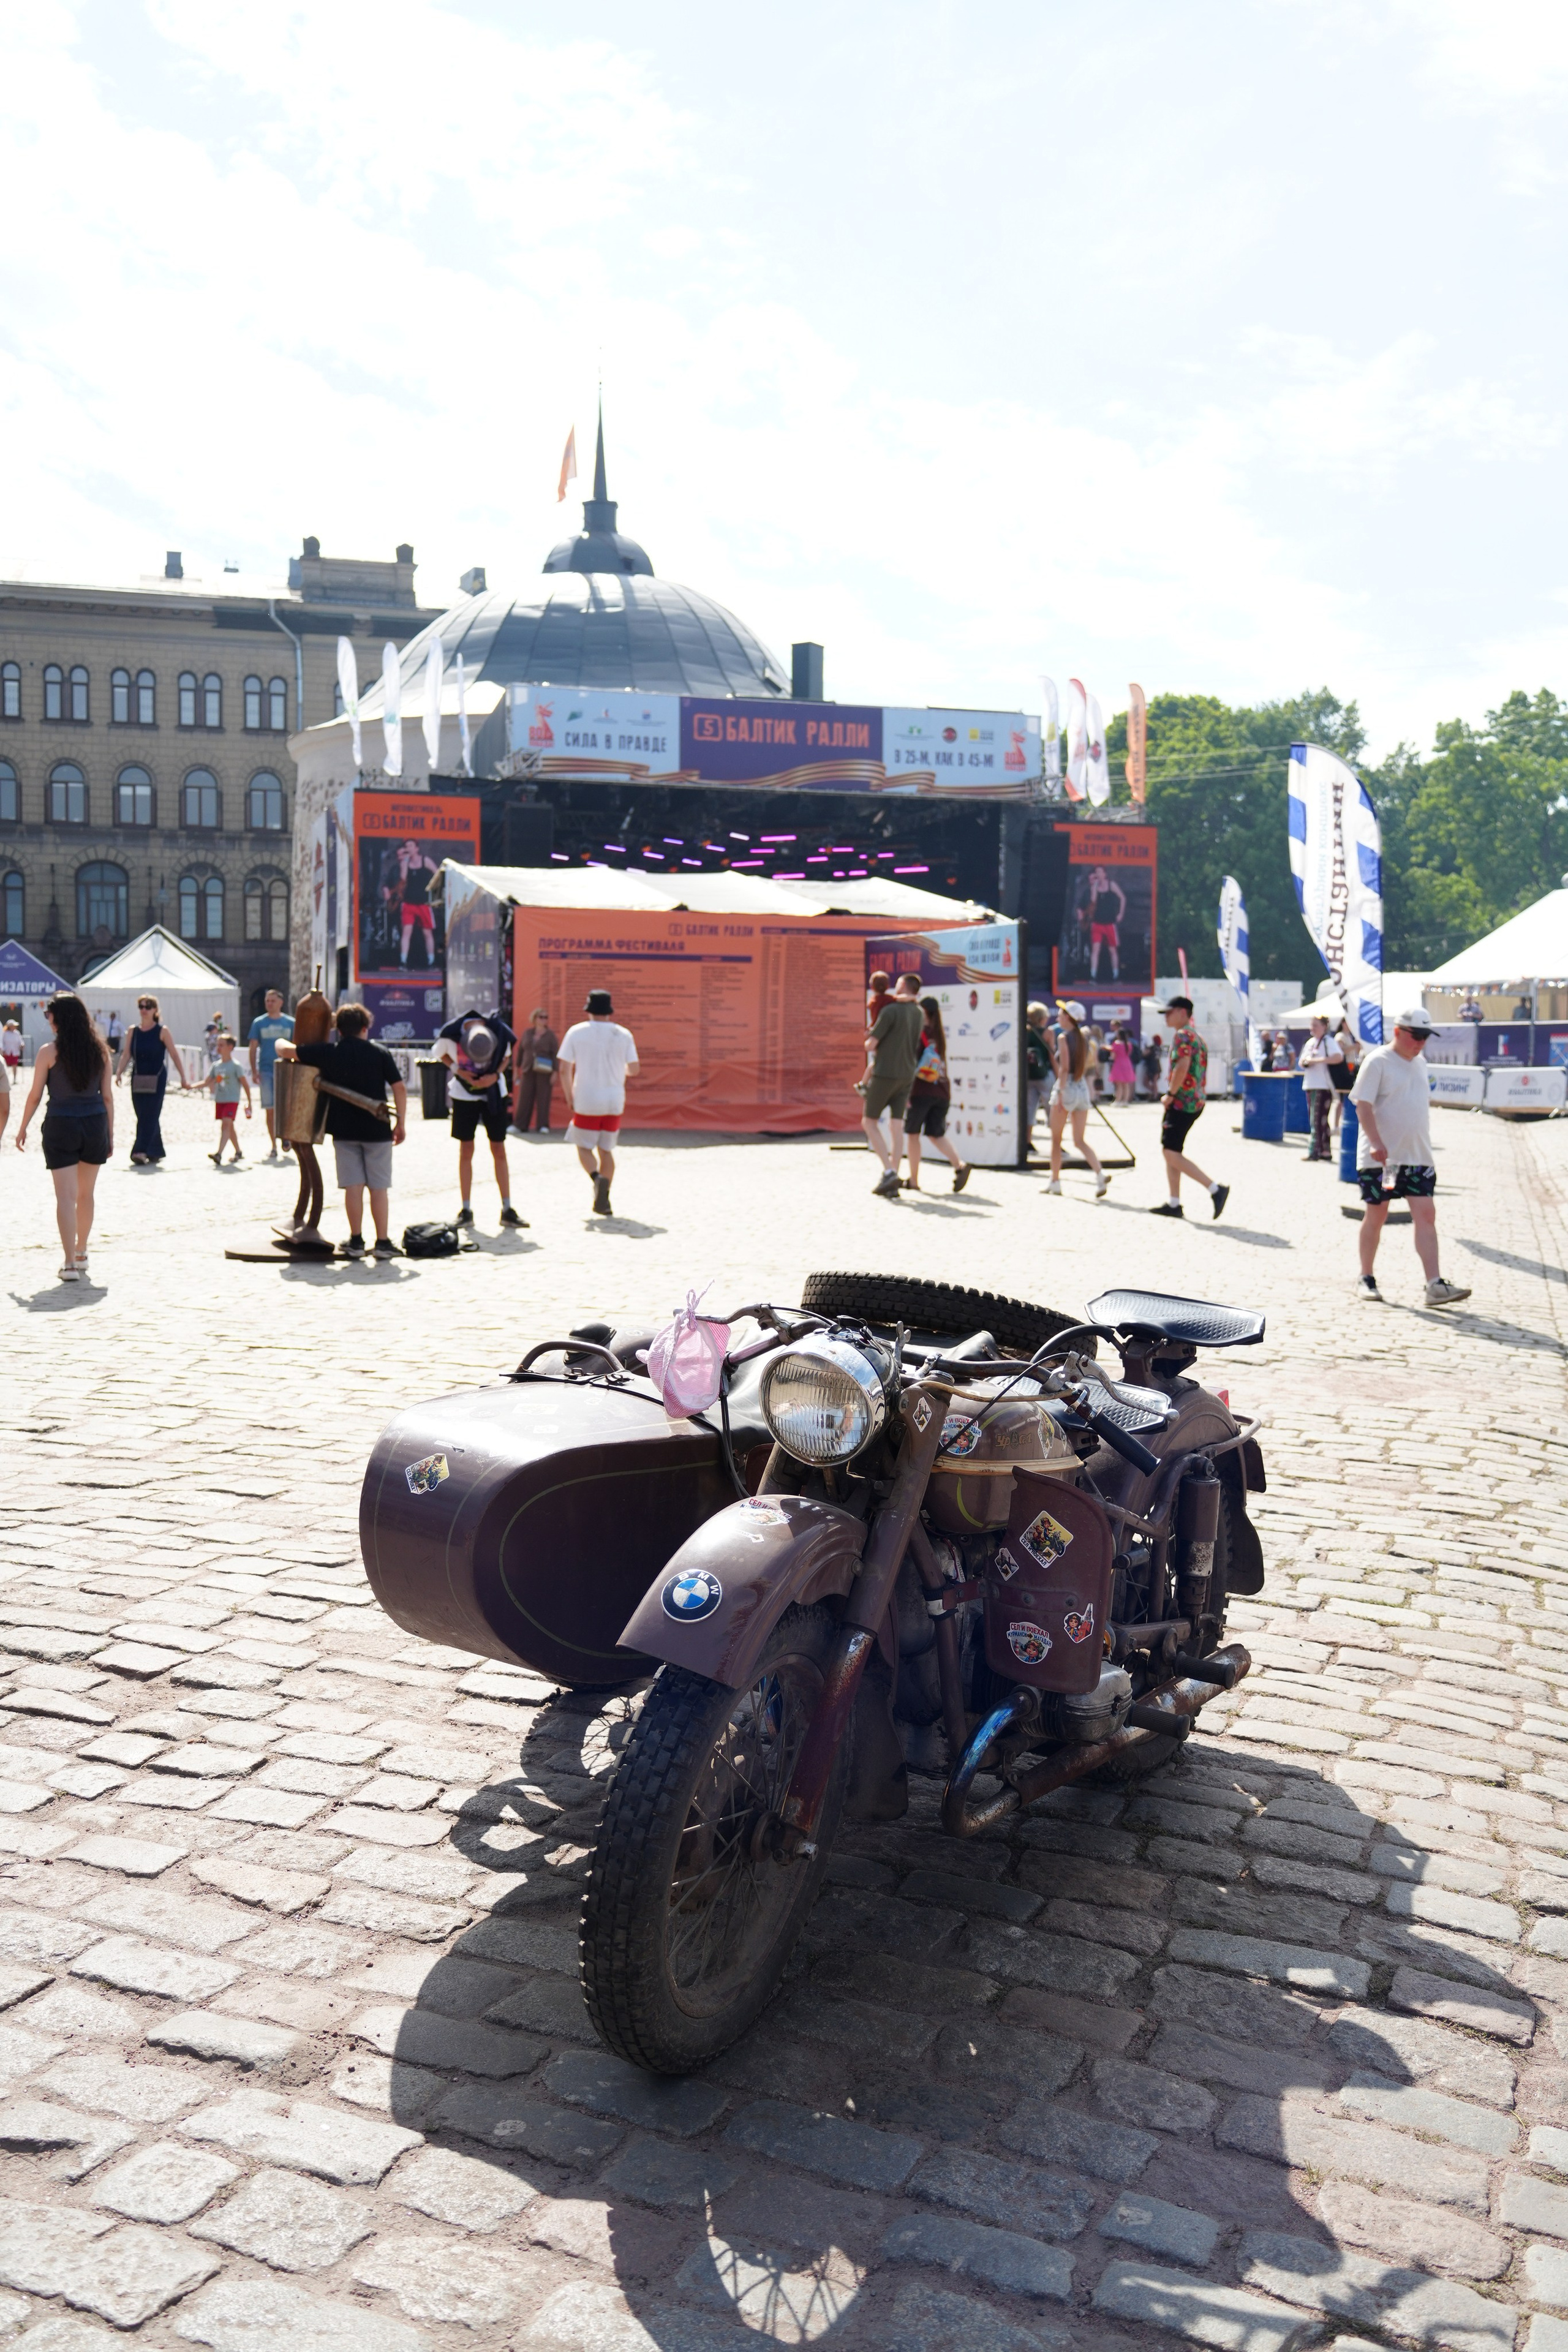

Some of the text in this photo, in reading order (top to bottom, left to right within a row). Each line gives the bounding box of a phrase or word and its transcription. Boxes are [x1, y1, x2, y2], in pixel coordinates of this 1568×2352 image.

[726, 717, 796, 745] БАЛТИК
[807, 720, 870, 748] РАЛЛИ
[565, 731, 598, 748] СИЛА
[605, 734, 612, 749] В
[619, 735, 668, 753] ПРАВДЕ
[894, 749, 900, 764] В
[935, 752, 952, 765] КАК
[958, 752, 963, 766] В
[383, 815, 471, 831] БАЛТИК РАЛЛИ
[686, 924, 719, 936] БАЛТИК
[723, 925, 754, 937] РАЛЛИ
[538, 937, 685, 952] ПРОГРАММА ФЕСТИВАЛЯ
[956, 1418, 978, 1427] ПОЕХЛ
[748, 1498, 762, 1507] СЕЛ
[1031, 1550, 1047, 1566] ПОЕХАЛ
[678, 1572, 719, 1595] BMW
[1027, 1626, 1049, 1638] ПОЕХАЛ
[1034, 1635, 1051, 1646] МАГАДАН
